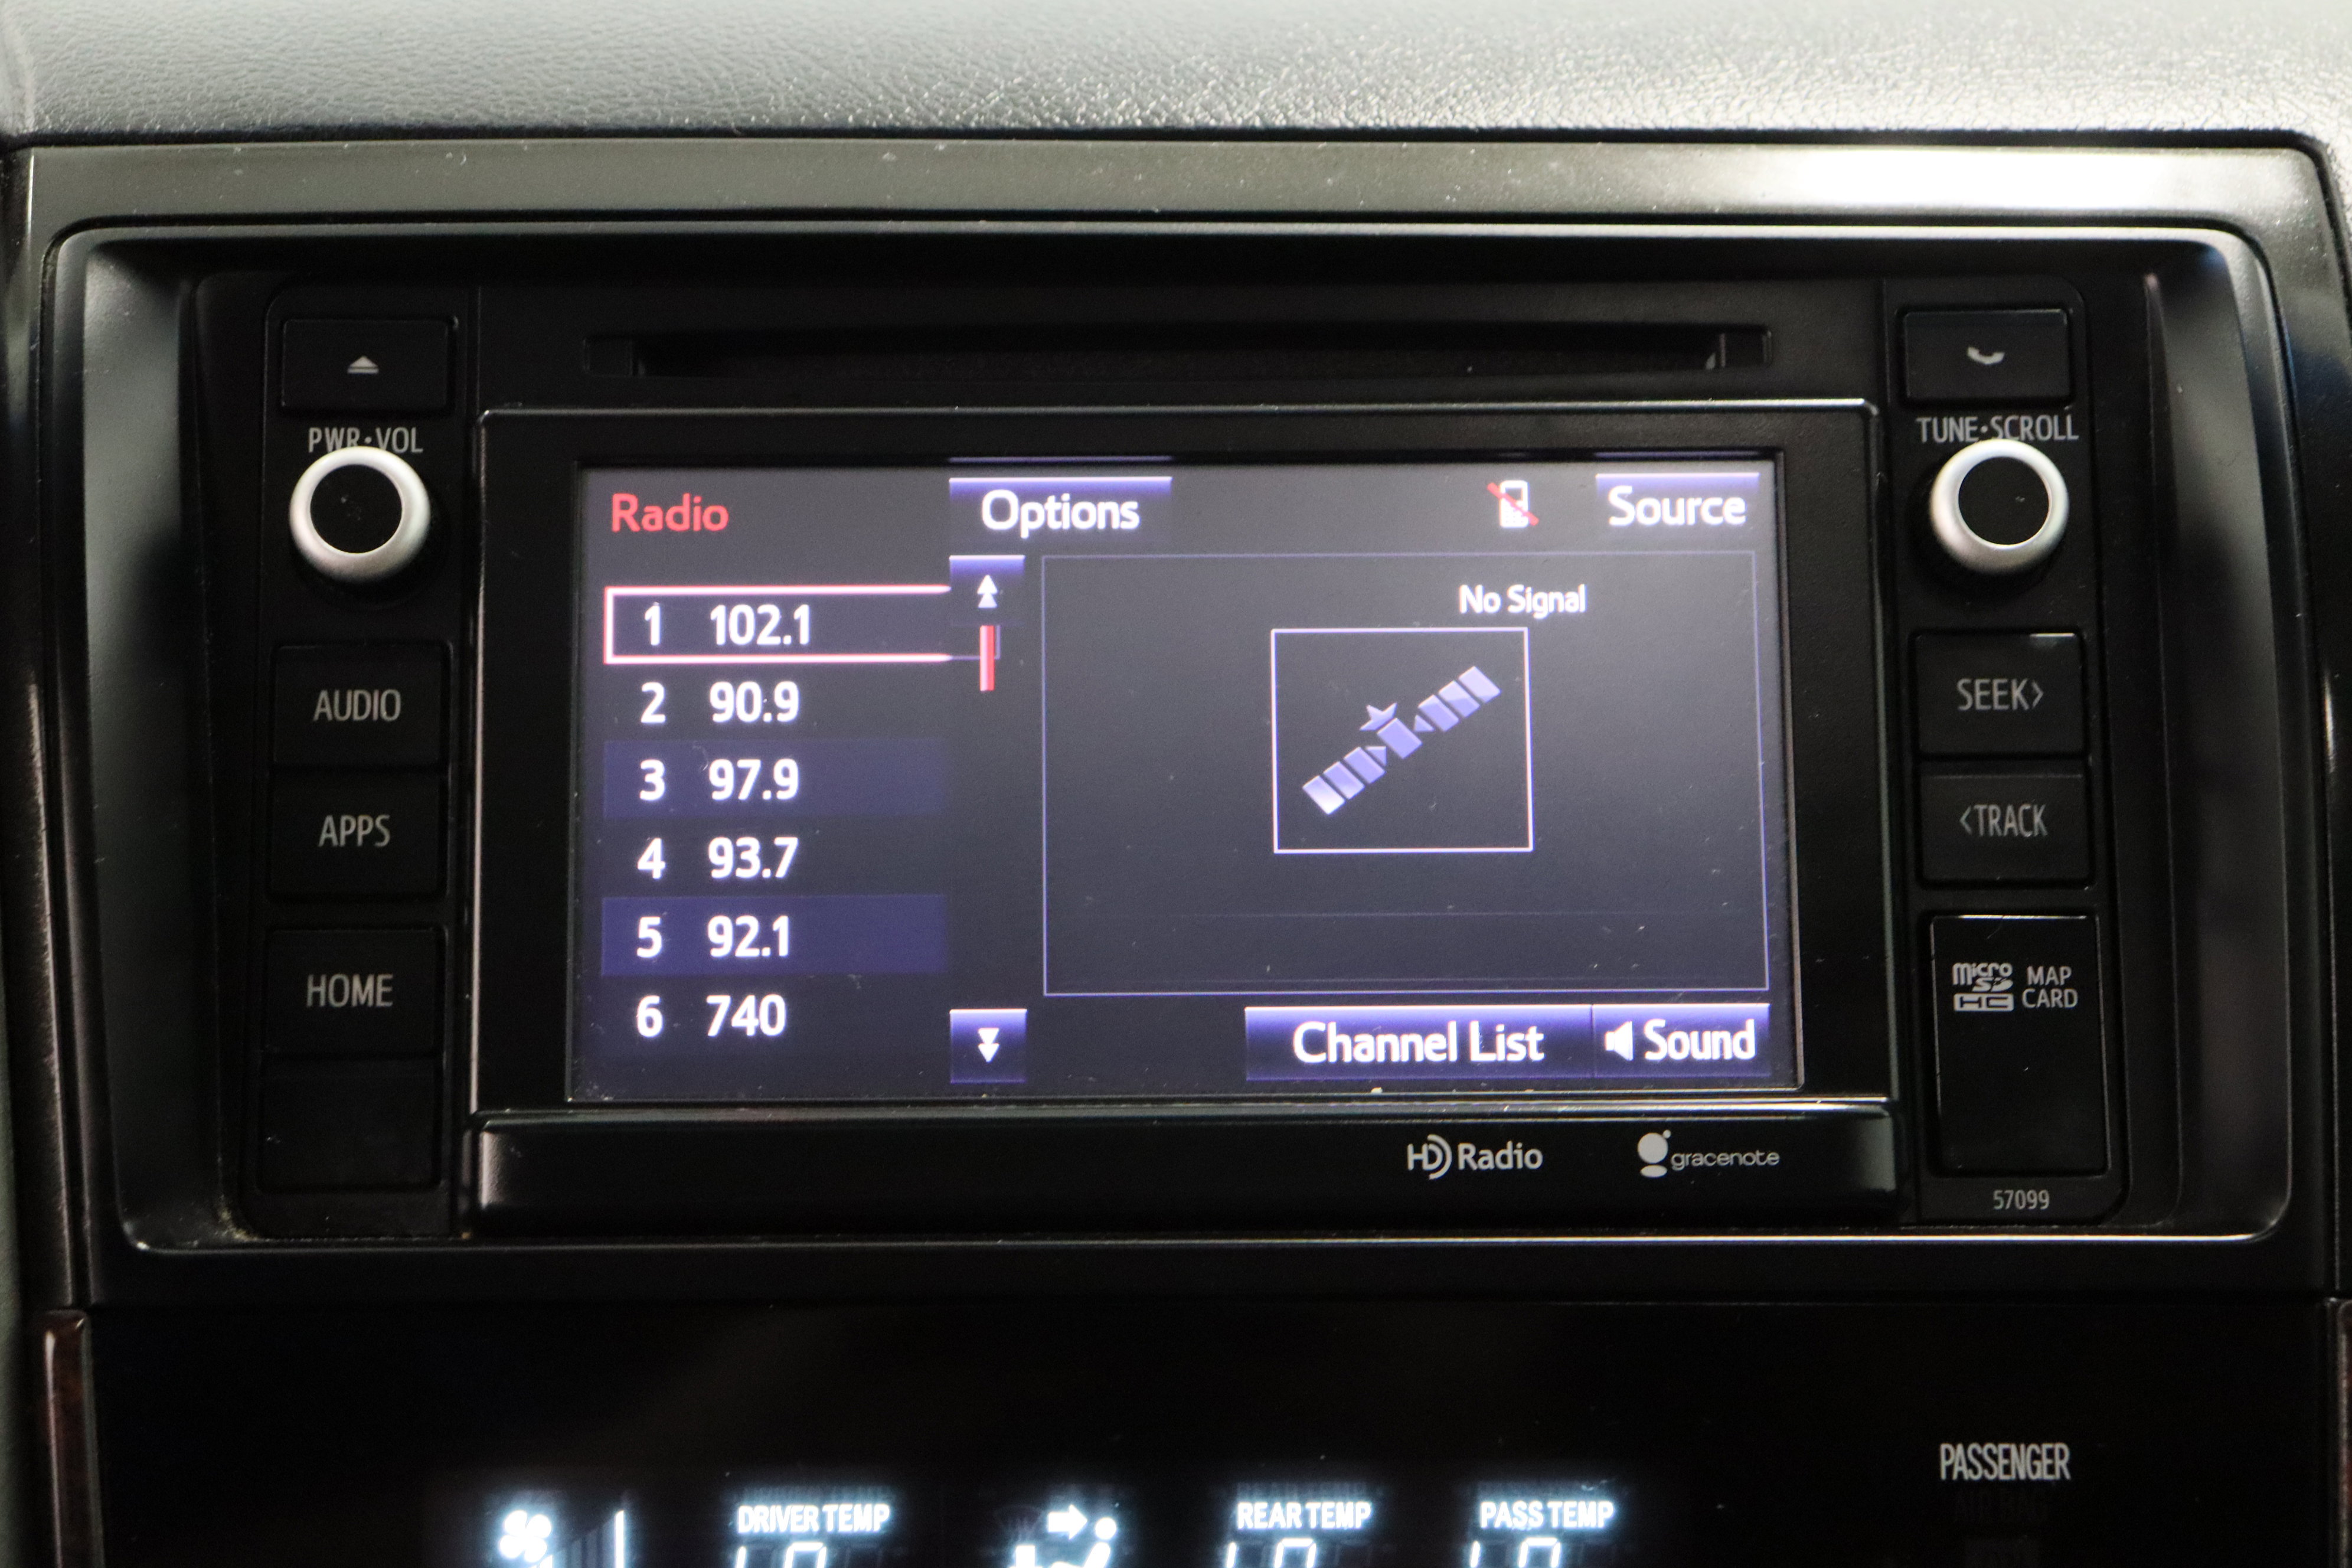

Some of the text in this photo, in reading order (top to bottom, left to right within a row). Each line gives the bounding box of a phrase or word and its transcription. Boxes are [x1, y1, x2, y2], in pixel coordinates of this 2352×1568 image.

[611, 493, 729, 532] Radio
[981, 489, 1141, 539] Options
[1607, 485, 1747, 526] Source
[1459, 584, 1587, 619] No Signal
[643, 604, 811, 646] 1 102.1
[313, 690, 401, 721] AUDIO
[641, 681, 799, 723] 2 90.9
[639, 759, 799, 801] 3 97.9
[318, 815, 391, 847] APPS
[637, 837, 798, 879] 4 93.7
[636, 915, 789, 958] 5 92.1
[306, 974, 394, 1007] HOME
[2027, 965, 2072, 986] MAP
[636, 995, 787, 1038] 6 740
[2022, 988, 2078, 1008] CARD
[1293, 1021, 1546, 1064] Channel List
[1644, 1018, 1756, 1061] Sound
[1407, 1134, 1543, 1180] HD Radio
[1671, 1150, 1780, 1171] gracenote
[1992, 1190, 2050, 1210] 57099
[1940, 1443, 2070, 1480] PASSENGER
[737, 1504, 890, 1534] DRIVER TEMP
[1237, 1501, 1371, 1529] REAR TEMP
[1480, 1501, 1614, 1528] PASS TEMP
